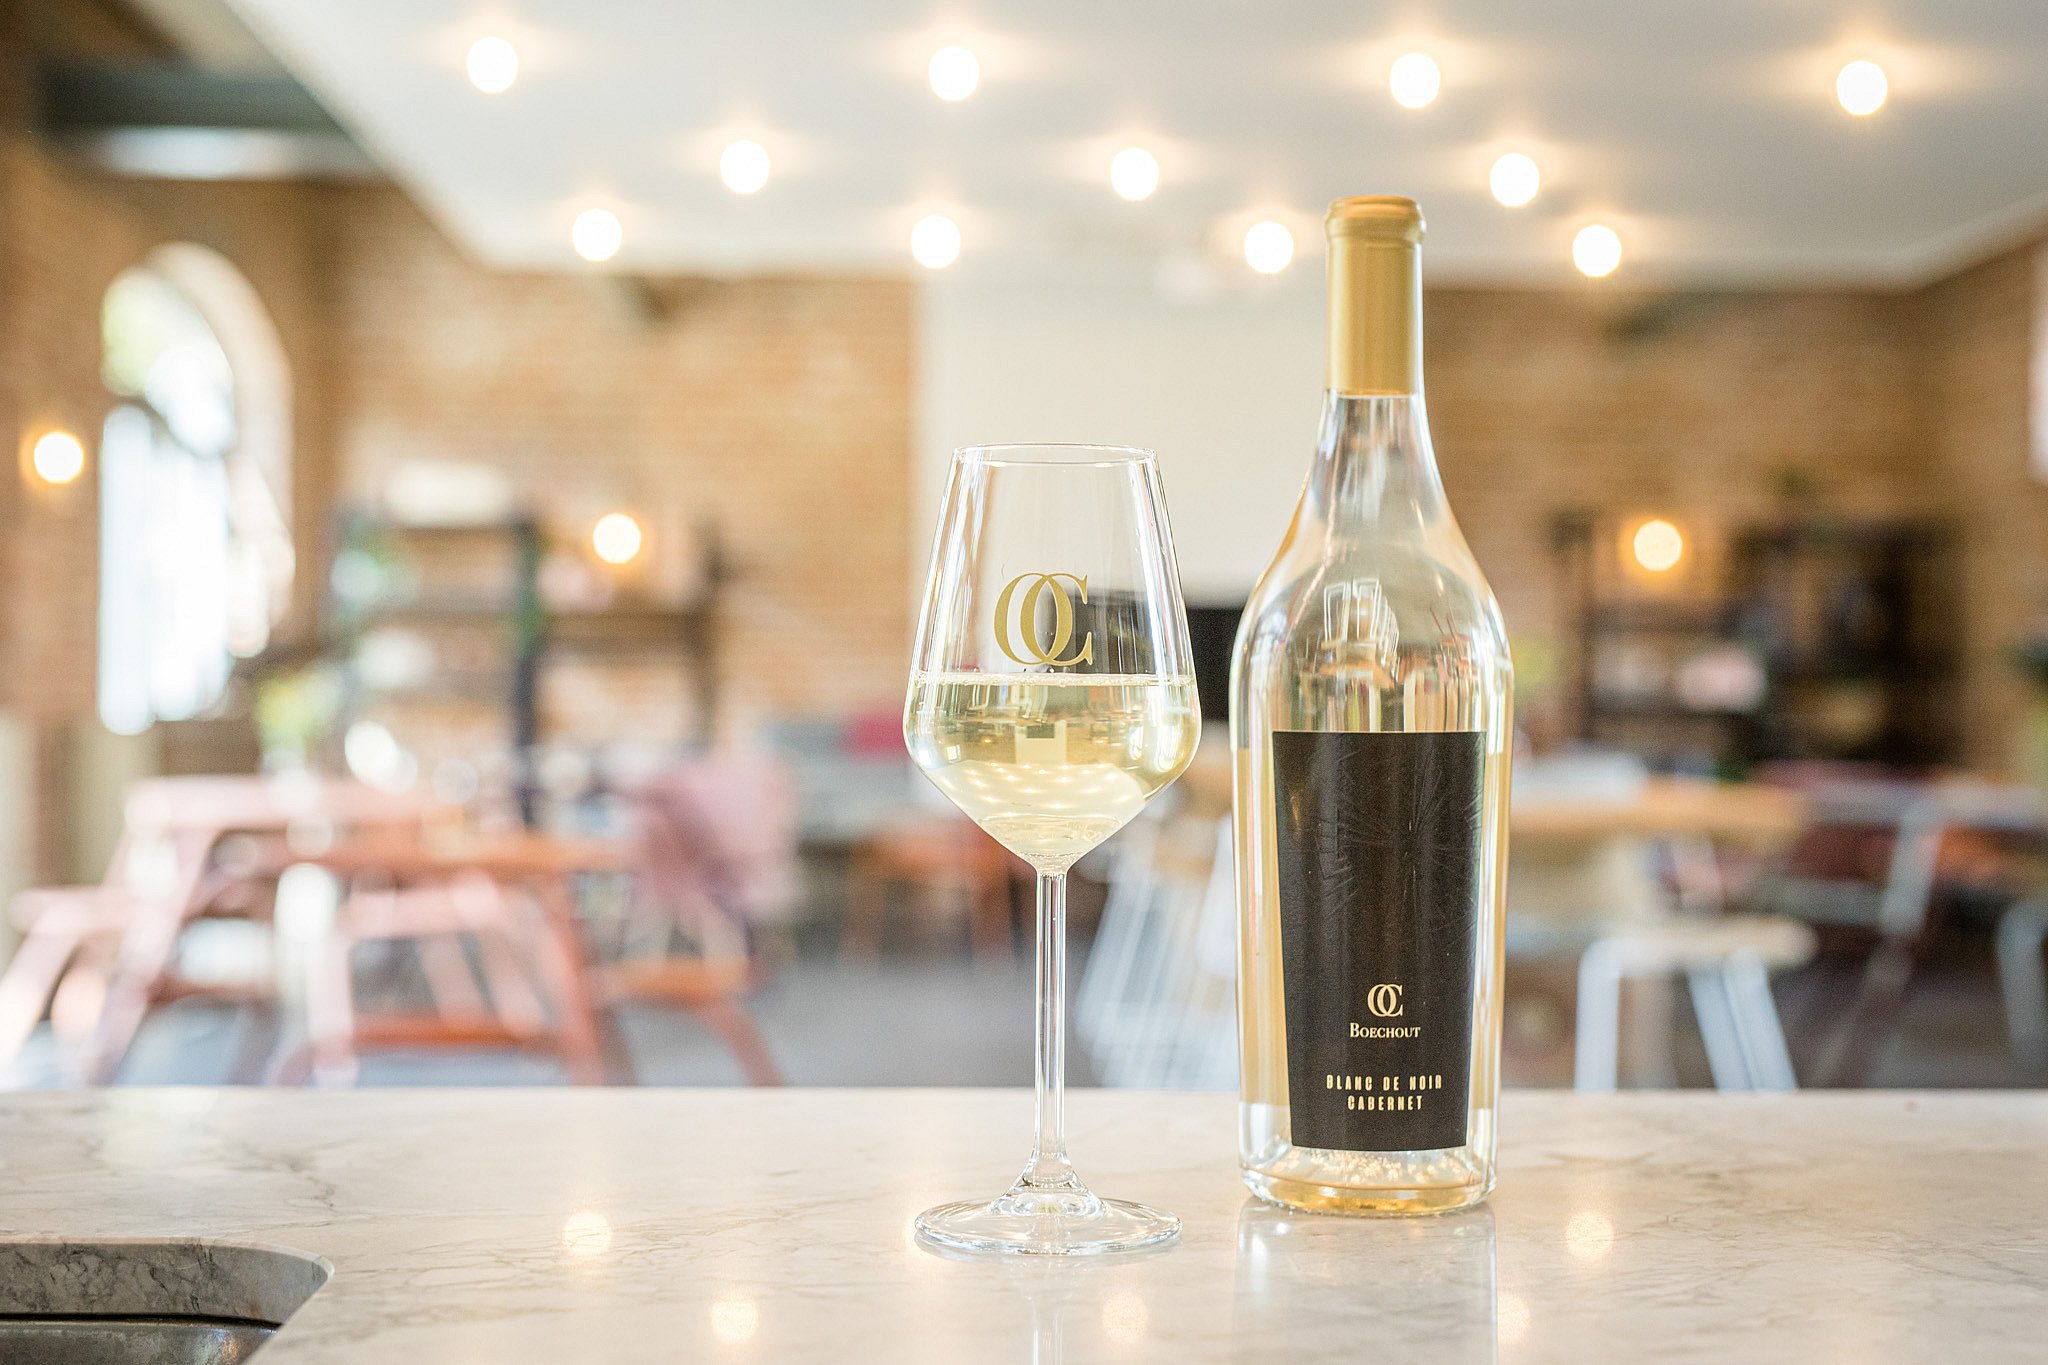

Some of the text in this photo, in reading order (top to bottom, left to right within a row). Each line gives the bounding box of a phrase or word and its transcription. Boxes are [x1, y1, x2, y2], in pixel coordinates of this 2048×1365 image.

[1349, 1022, 1421, 1038] BOECHOUT
[1326, 1074, 1442, 1091] BLANC DE NOIR
[1347, 1095, 1423, 1111] CABERNET
